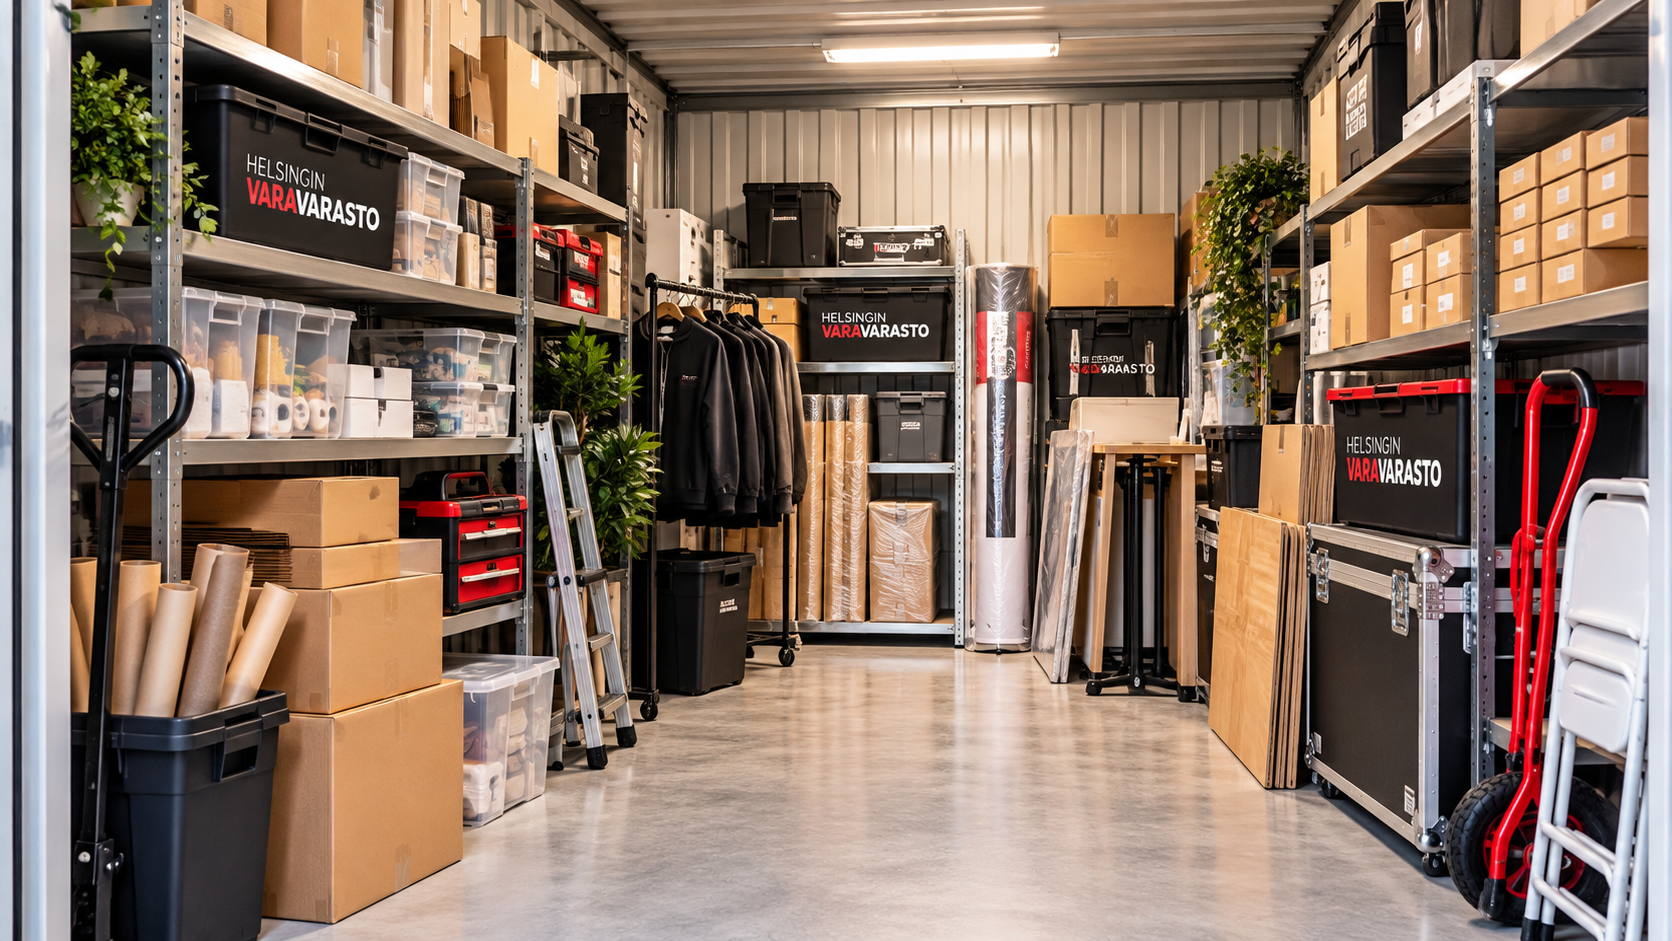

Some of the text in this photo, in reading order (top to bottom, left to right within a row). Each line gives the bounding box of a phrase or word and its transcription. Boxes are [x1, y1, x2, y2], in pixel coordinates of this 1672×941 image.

[246, 153, 325, 192] HELSINGIN
[246, 177, 380, 231] VARAVARASTO
[821, 311, 886, 323] HELSINGIN
[821, 323, 930, 339] VARAVARASTO
[1346, 436, 1401, 455] HELSINGIN
[1346, 457, 1442, 488] VARAVARASTO
